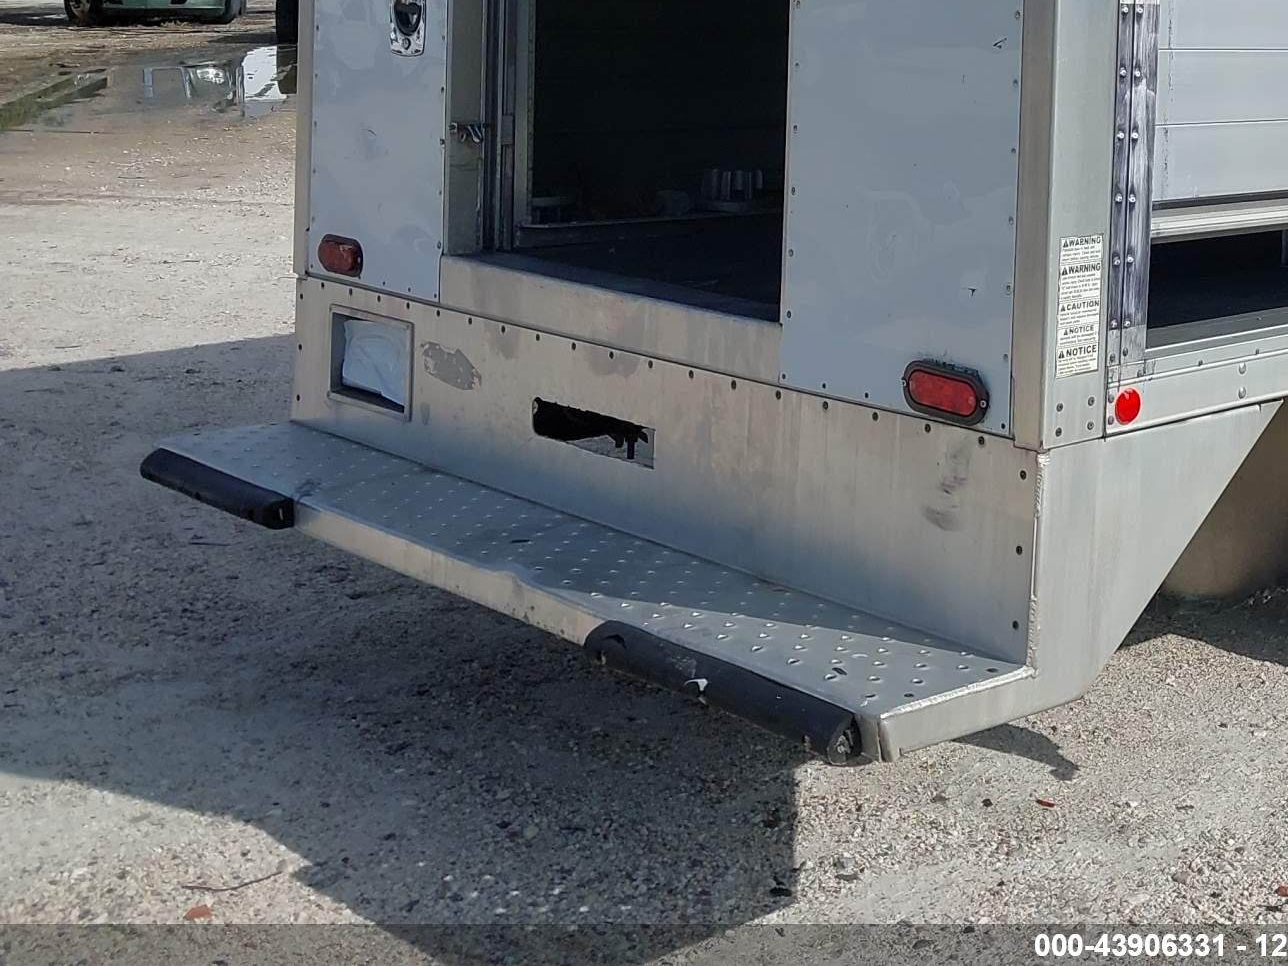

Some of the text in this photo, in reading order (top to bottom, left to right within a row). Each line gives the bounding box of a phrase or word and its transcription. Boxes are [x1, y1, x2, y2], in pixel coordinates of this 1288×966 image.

[1069, 237, 1101, 247] WARNING
[1068, 263, 1101, 275] WARNING
[1066, 300, 1100, 311] CAUTION
[1069, 324, 1095, 334] NOTICE
[1066, 344, 1097, 357] NOTICE
